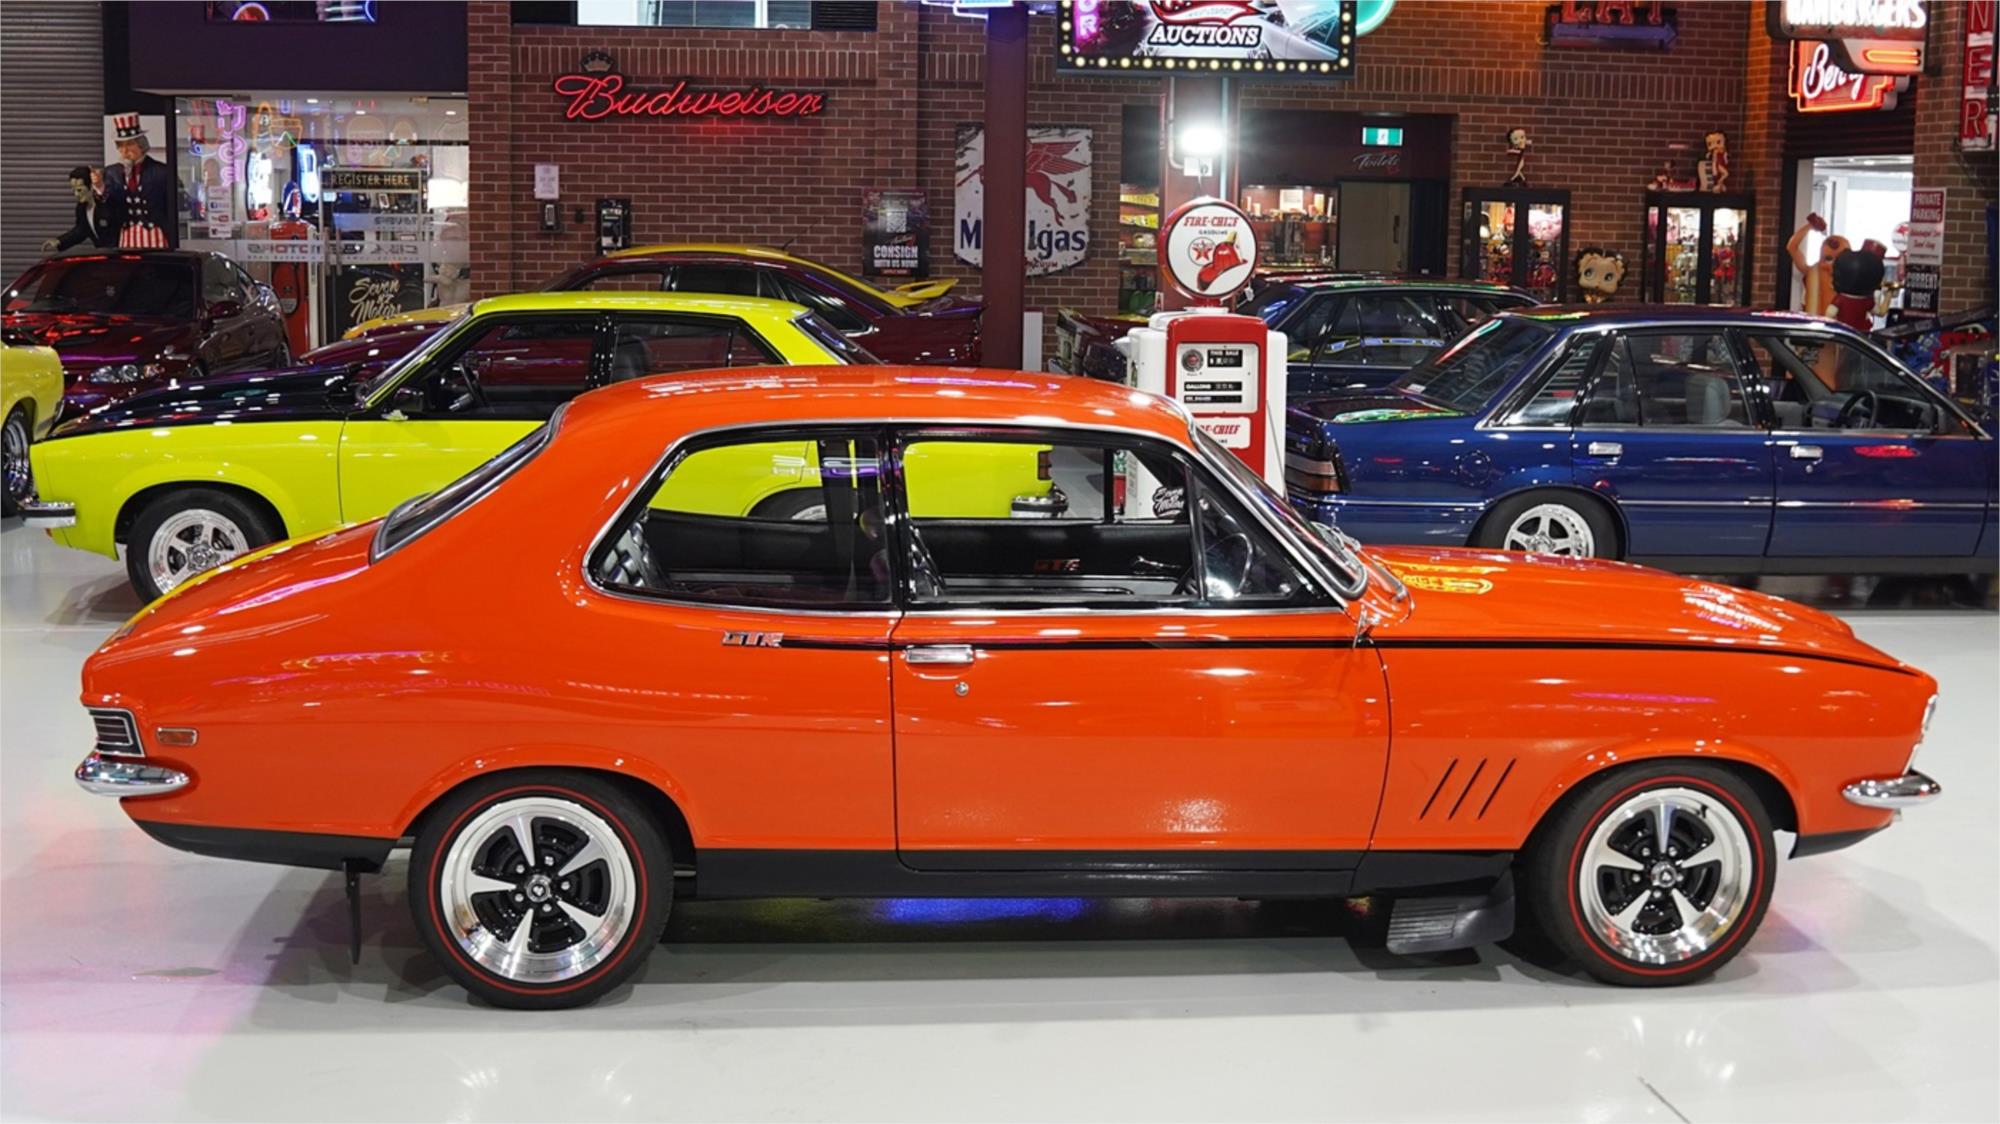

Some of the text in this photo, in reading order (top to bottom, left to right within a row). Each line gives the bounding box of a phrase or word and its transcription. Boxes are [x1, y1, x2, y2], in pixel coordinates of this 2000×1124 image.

[1150, 25, 1260, 46] AUCTIONS
[554, 74, 823, 119] Budweiser
[330, 174, 409, 185] REGISTER HERE
[960, 218, 1086, 260] Mlgas
[873, 244, 919, 259] CONSIGN
[348, 277, 400, 304] Seven
